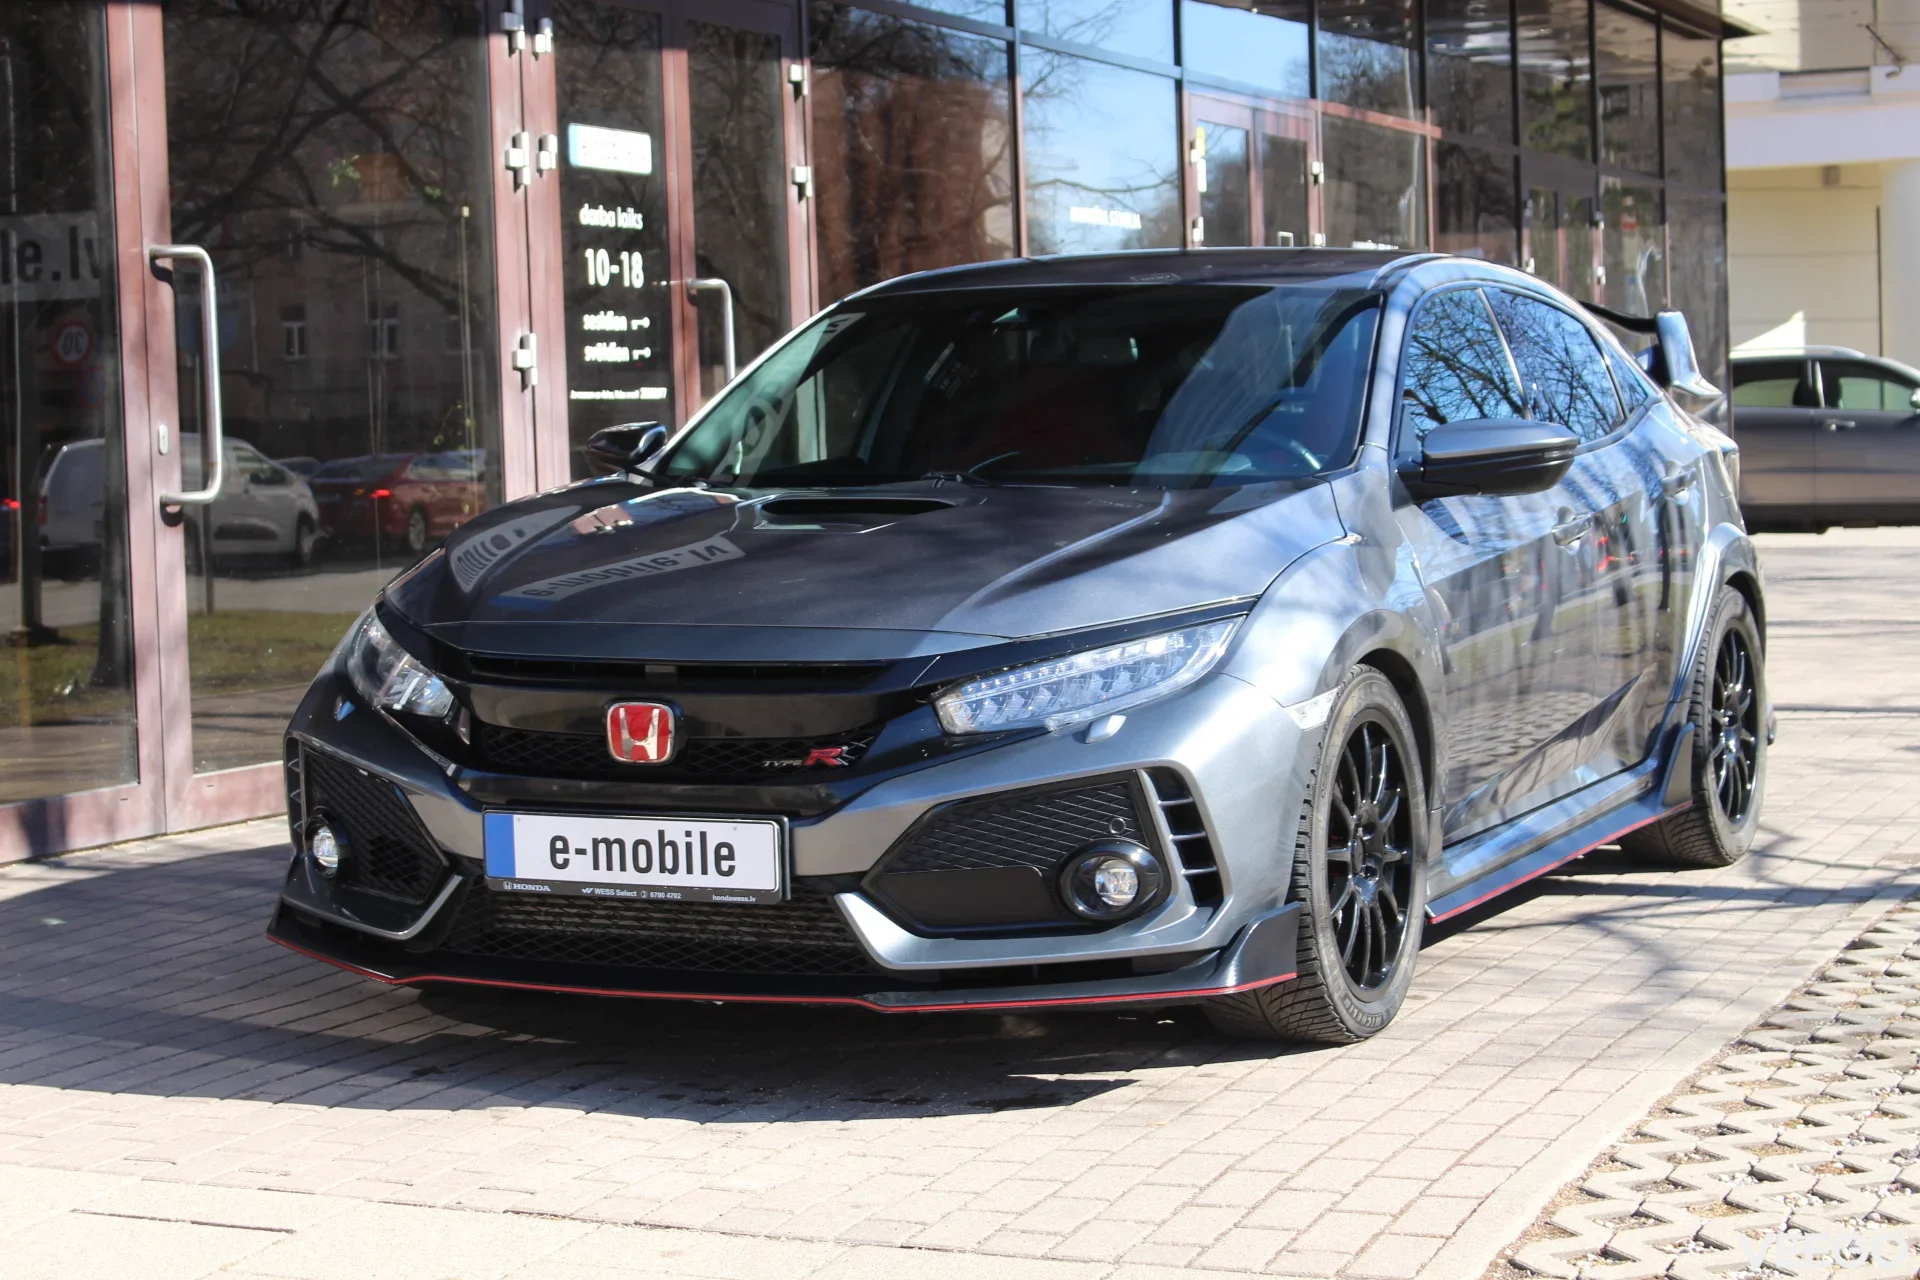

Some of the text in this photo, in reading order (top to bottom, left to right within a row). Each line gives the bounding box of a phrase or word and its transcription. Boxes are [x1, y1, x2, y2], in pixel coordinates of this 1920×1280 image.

[579, 203, 643, 229] darba laiks
[585, 248, 644, 288] 10-18
[549, 829, 736, 878] e-mobile
[513, 883, 551, 892] HONDA
[594, 888, 615, 896] WESS
[616, 889, 638, 897] Select
